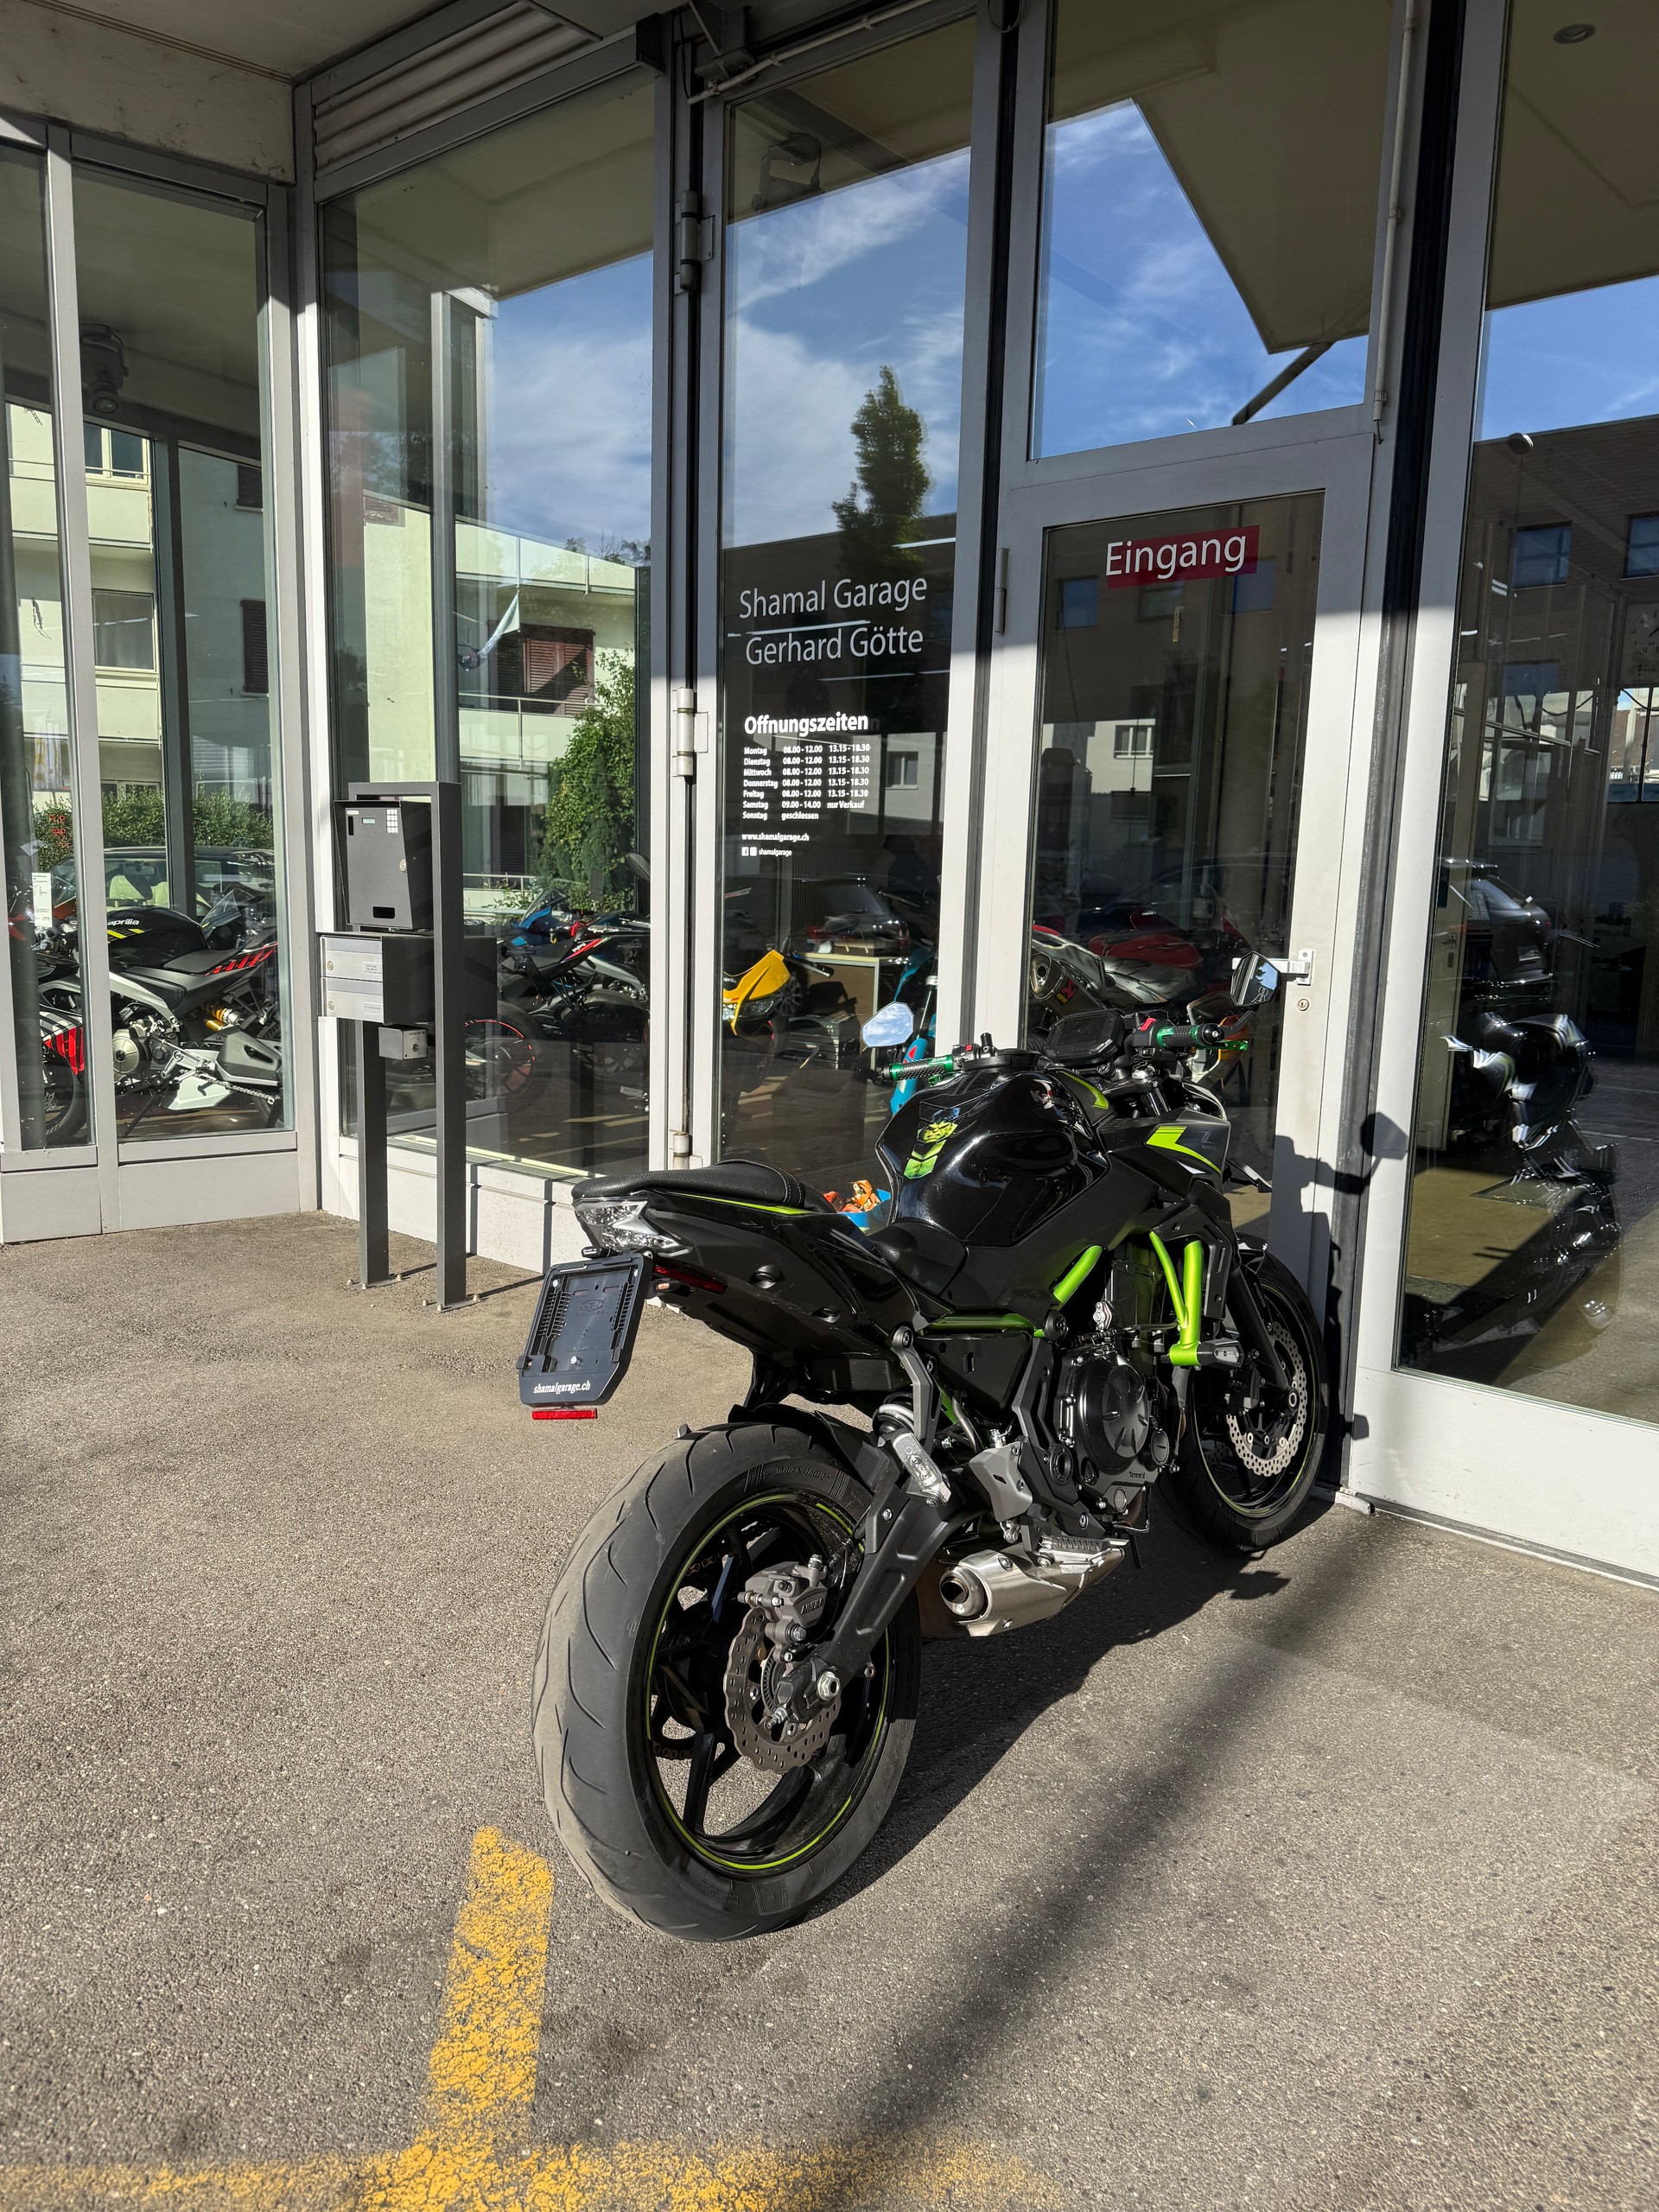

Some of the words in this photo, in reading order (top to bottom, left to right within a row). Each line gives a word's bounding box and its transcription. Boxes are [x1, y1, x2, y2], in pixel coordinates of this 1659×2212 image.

[1105, 536, 1246, 580] Eingang
[739, 580, 826, 619] Shamal
[833, 578, 927, 612] Garage
[746, 628, 842, 665] Gerhard
[849, 625, 924, 658] Götte
[743, 747, 767, 756] Montag
[743, 758, 771, 766] Dienstag
[829, 755, 846, 764] 13.15
[851, 755, 869, 764] 18.30
[743, 768, 772, 777] Mittwoch
[829, 766, 846, 775] 13.15
[851, 766, 869, 775] 18.30
[743, 779, 779, 789] Donnerstag
[829, 778, 846, 786] 13.15
[851, 778, 869, 786] 18.30
[742, 790, 765, 799] Freitag
[829, 789, 846, 798] 13.15
[851, 789, 869, 798] 18.30
[742, 801, 769, 810] Samstag
[782, 800, 799, 809] 09.00
[804, 799, 822, 808] 14.00
[839, 800, 865, 809] Verkauf
[742, 811, 768, 821] Sonntag
[781, 810, 819, 821] geschlossen
[741, 832, 810, 842] www.shamalgarage.ch
[759, 848, 792, 857] shamalgarage
[107, 918, 140, 926] aprilia
[532, 1380, 591, 1395] shamalgarage.ch
